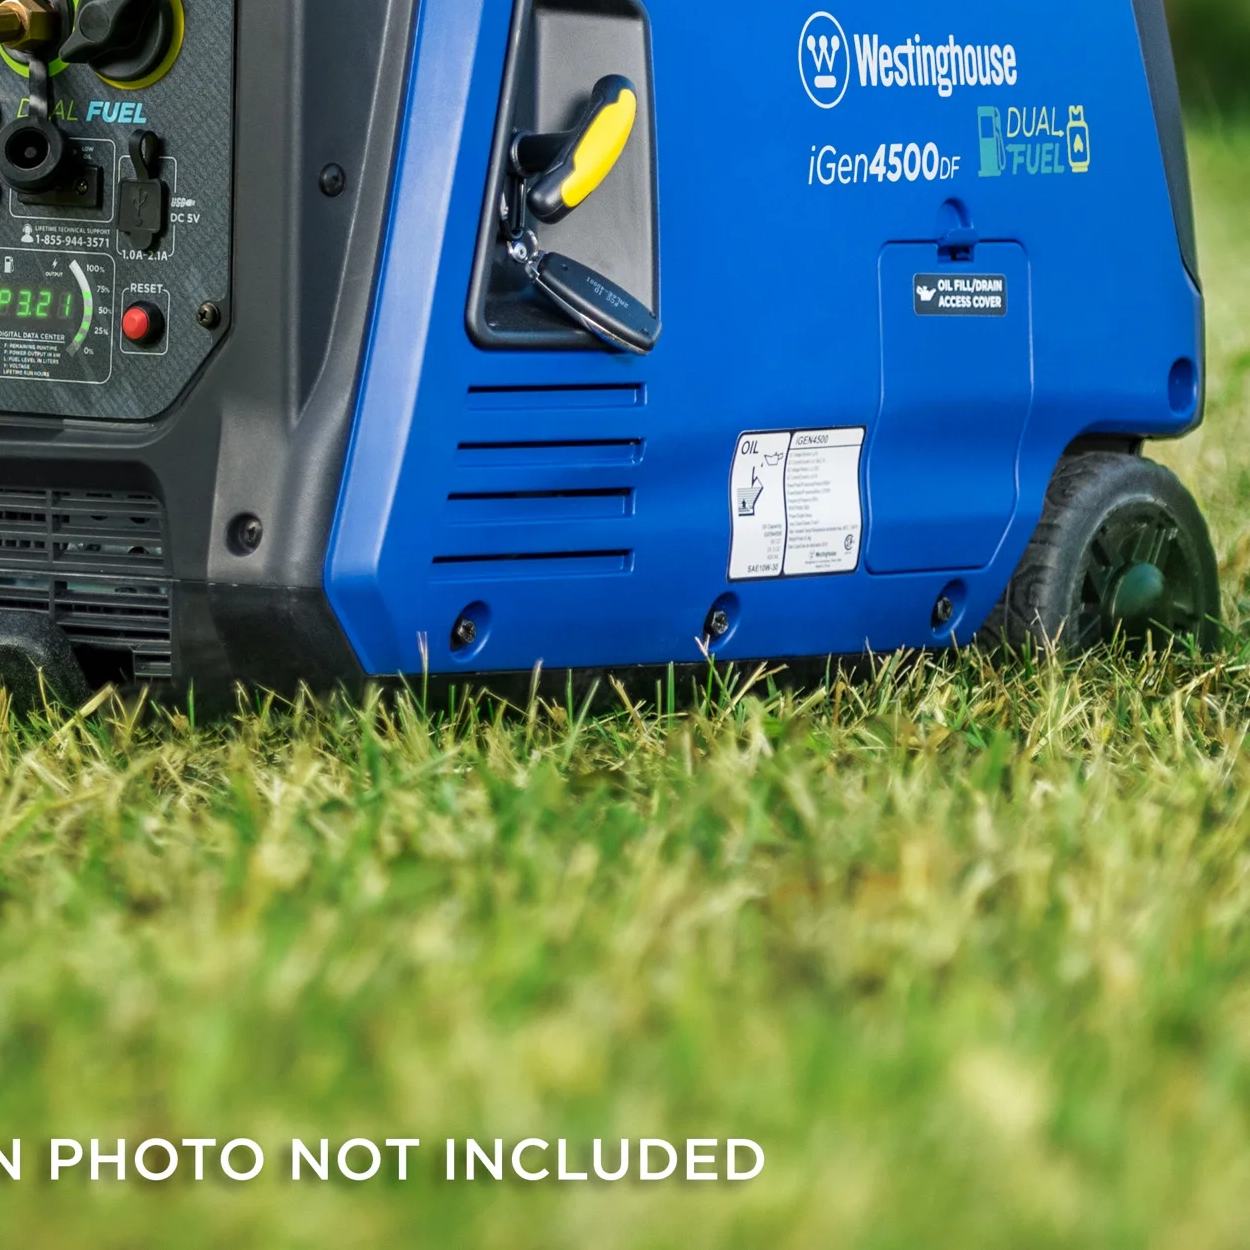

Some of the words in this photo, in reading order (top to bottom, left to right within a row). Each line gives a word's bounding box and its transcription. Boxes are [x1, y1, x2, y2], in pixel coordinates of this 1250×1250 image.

[853, 33, 1017, 98] Westinghouse
[17, 98, 78, 121] DAL
[86, 101, 147, 124] FUEL
[1006, 106, 1064, 137] DUAL
[808, 142, 961, 185] iGen4500DF
[1012, 142, 1065, 175] FUEL
[170, 213, 184, 223] DC
[187, 214, 201, 223] 5V
[35, 234, 110, 248] 1-855-944-3571
[122, 250, 168, 261] 1.0A-2.1A
[86, 264, 105, 273] 100%
[97, 285, 110, 293] 75%
[130, 283, 163, 294] RESET
[937, 279, 953, 292] OIL
[953, 279, 1003, 293] FILL/DRAIN
[938, 295, 972, 308] ACCESS
[972, 296, 1002, 308] COVER
[98, 306, 112, 315] 50%
[23, 332, 38, 340] DATA
[39, 333, 65, 341] CENTER
[94, 327, 109, 336] 25%
[84, 347, 94, 356] 0%
[741, 440, 759, 455] OIL
